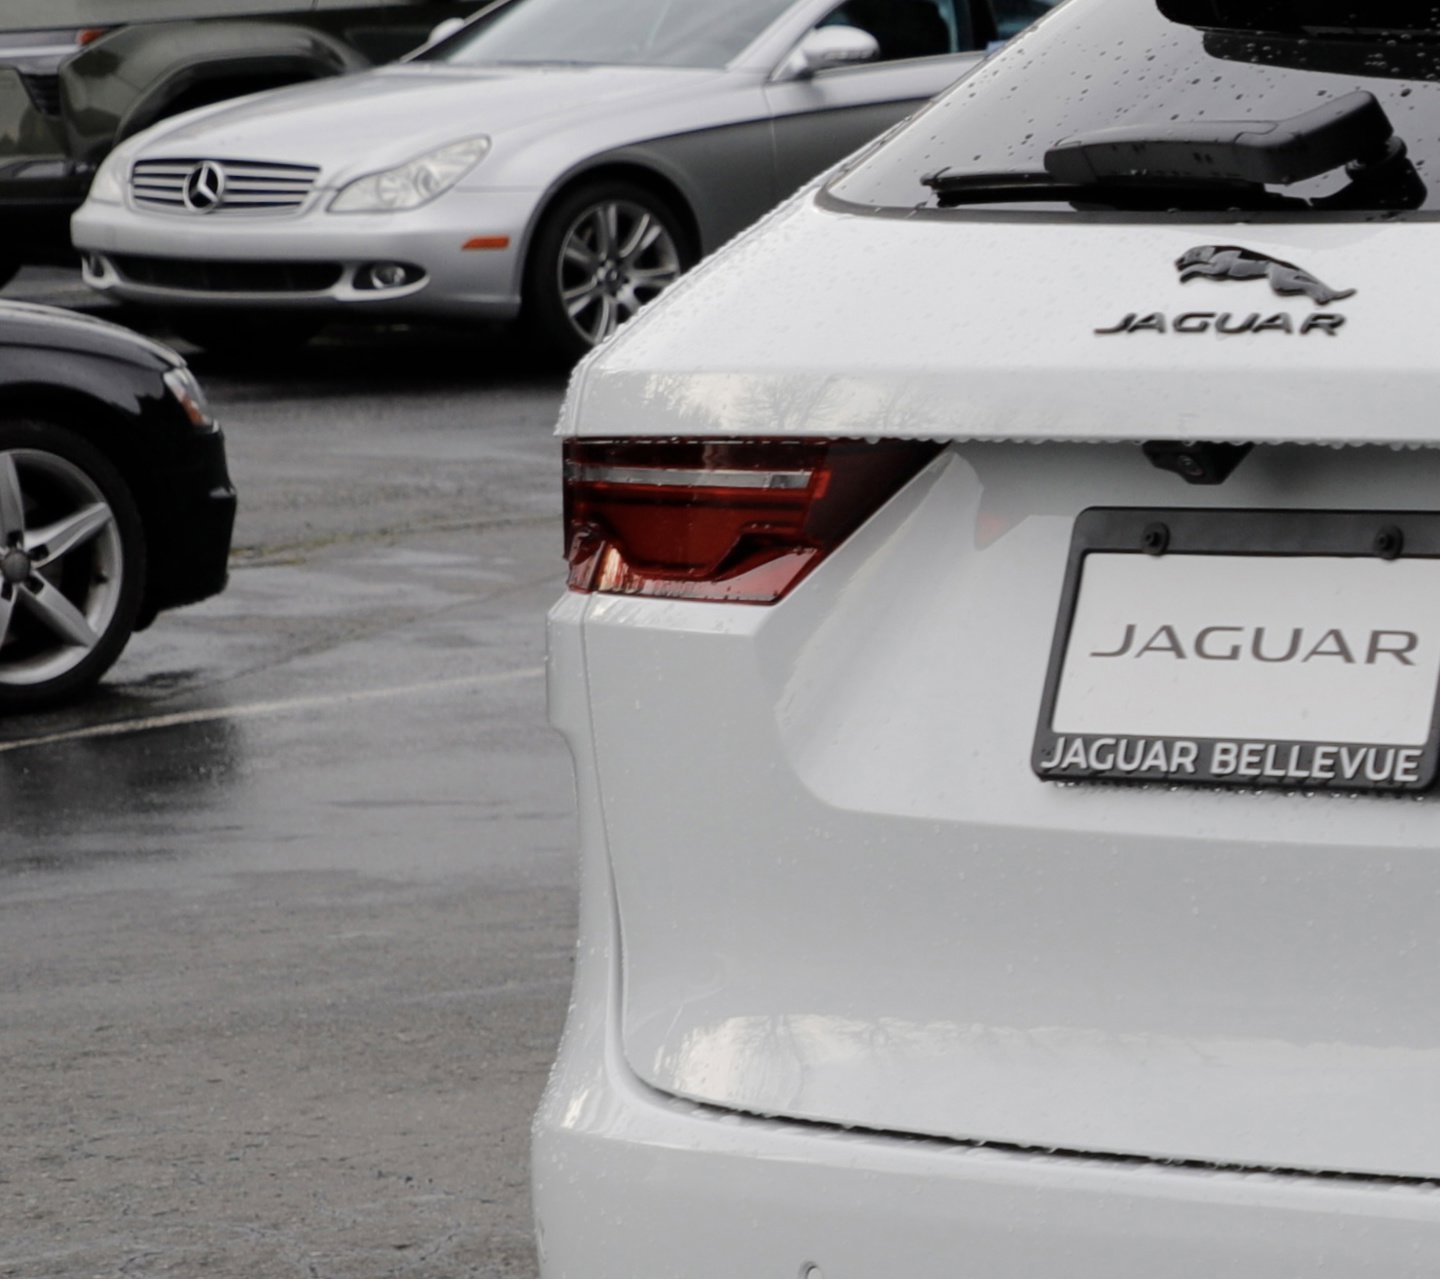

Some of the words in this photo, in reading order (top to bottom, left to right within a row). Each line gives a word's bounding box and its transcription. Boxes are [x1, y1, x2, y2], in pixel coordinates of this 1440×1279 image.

[1093, 312, 1347, 336] JAGUAR
[1089, 623, 1419, 666] JAGUAR
[1041, 736, 1197, 775] JAGUAR
[1209, 741, 1422, 782] BELLEVUE
